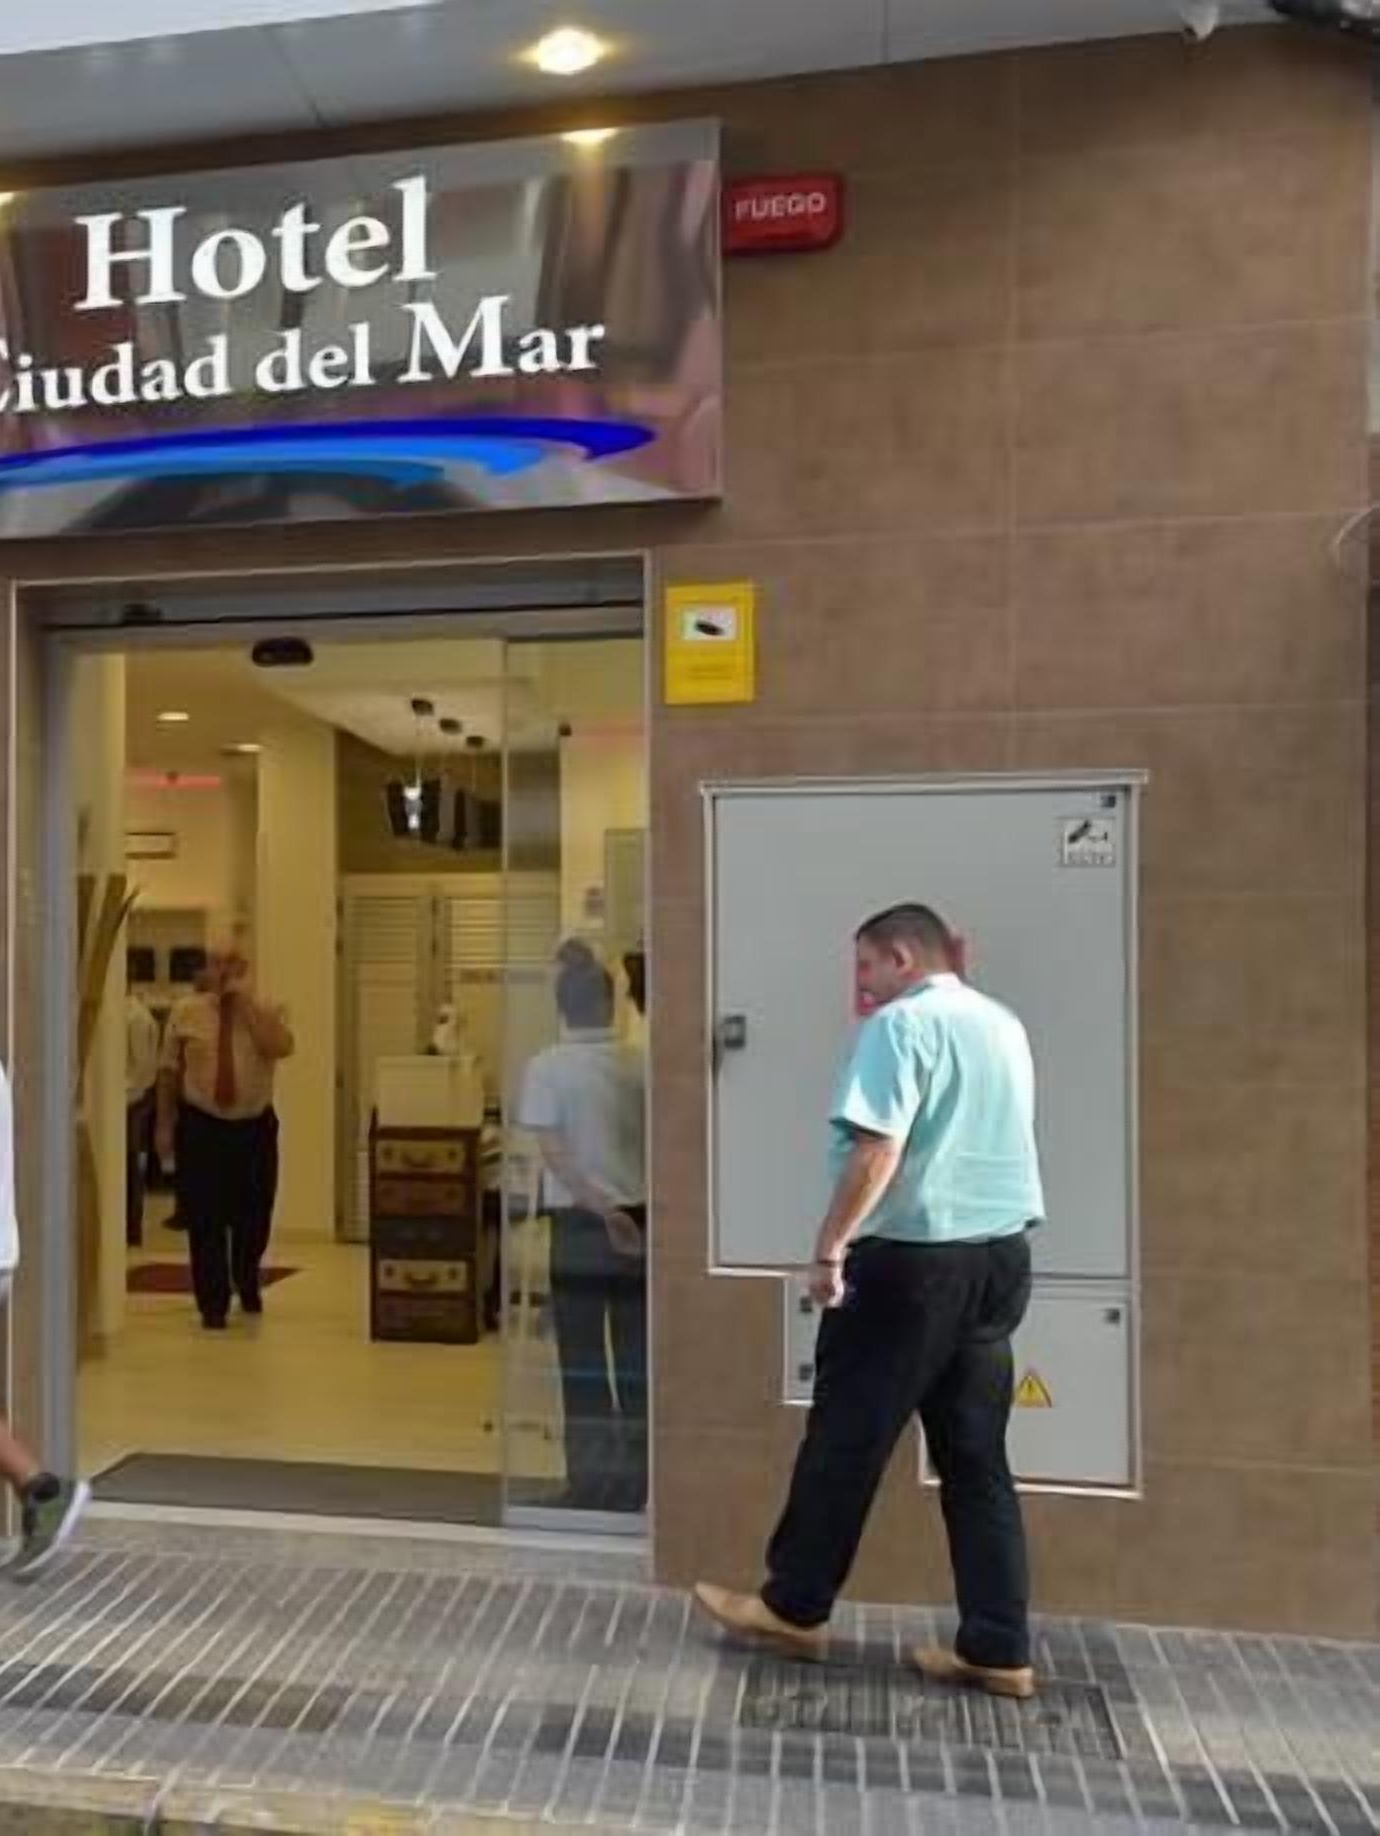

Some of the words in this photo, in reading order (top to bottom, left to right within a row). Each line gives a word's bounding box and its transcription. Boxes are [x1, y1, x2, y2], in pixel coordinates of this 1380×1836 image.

[75, 176, 438, 309] Hotel
[735, 192, 826, 221] FUEGO
[255, 322, 375, 392] del
[399, 295, 605, 382] Mar
